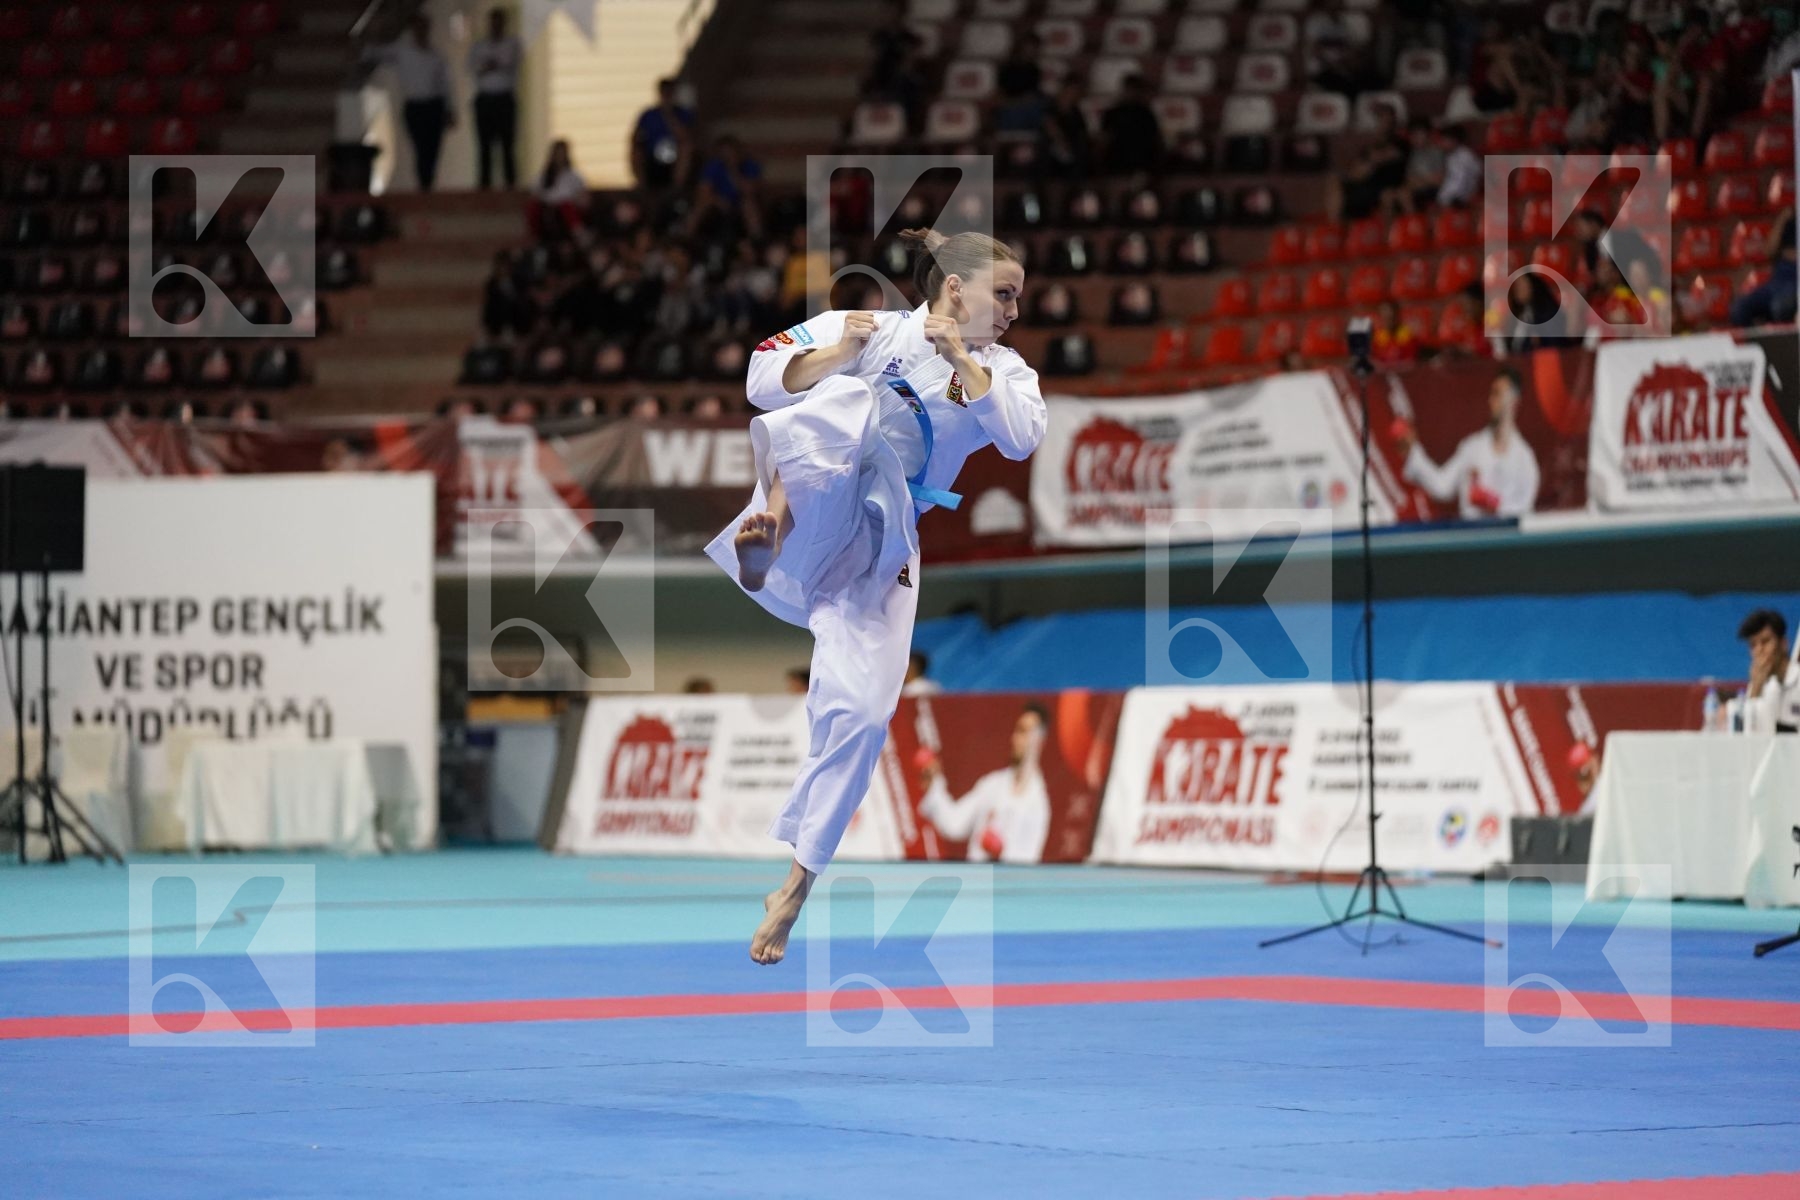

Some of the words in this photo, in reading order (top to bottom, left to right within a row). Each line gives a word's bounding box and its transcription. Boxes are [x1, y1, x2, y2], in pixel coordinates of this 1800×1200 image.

[0, 588, 199, 637] AZİANTEP
[212, 586, 385, 645] GENÇLİK
[95, 651, 142, 692] VE
[156, 651, 265, 692] SPOR
